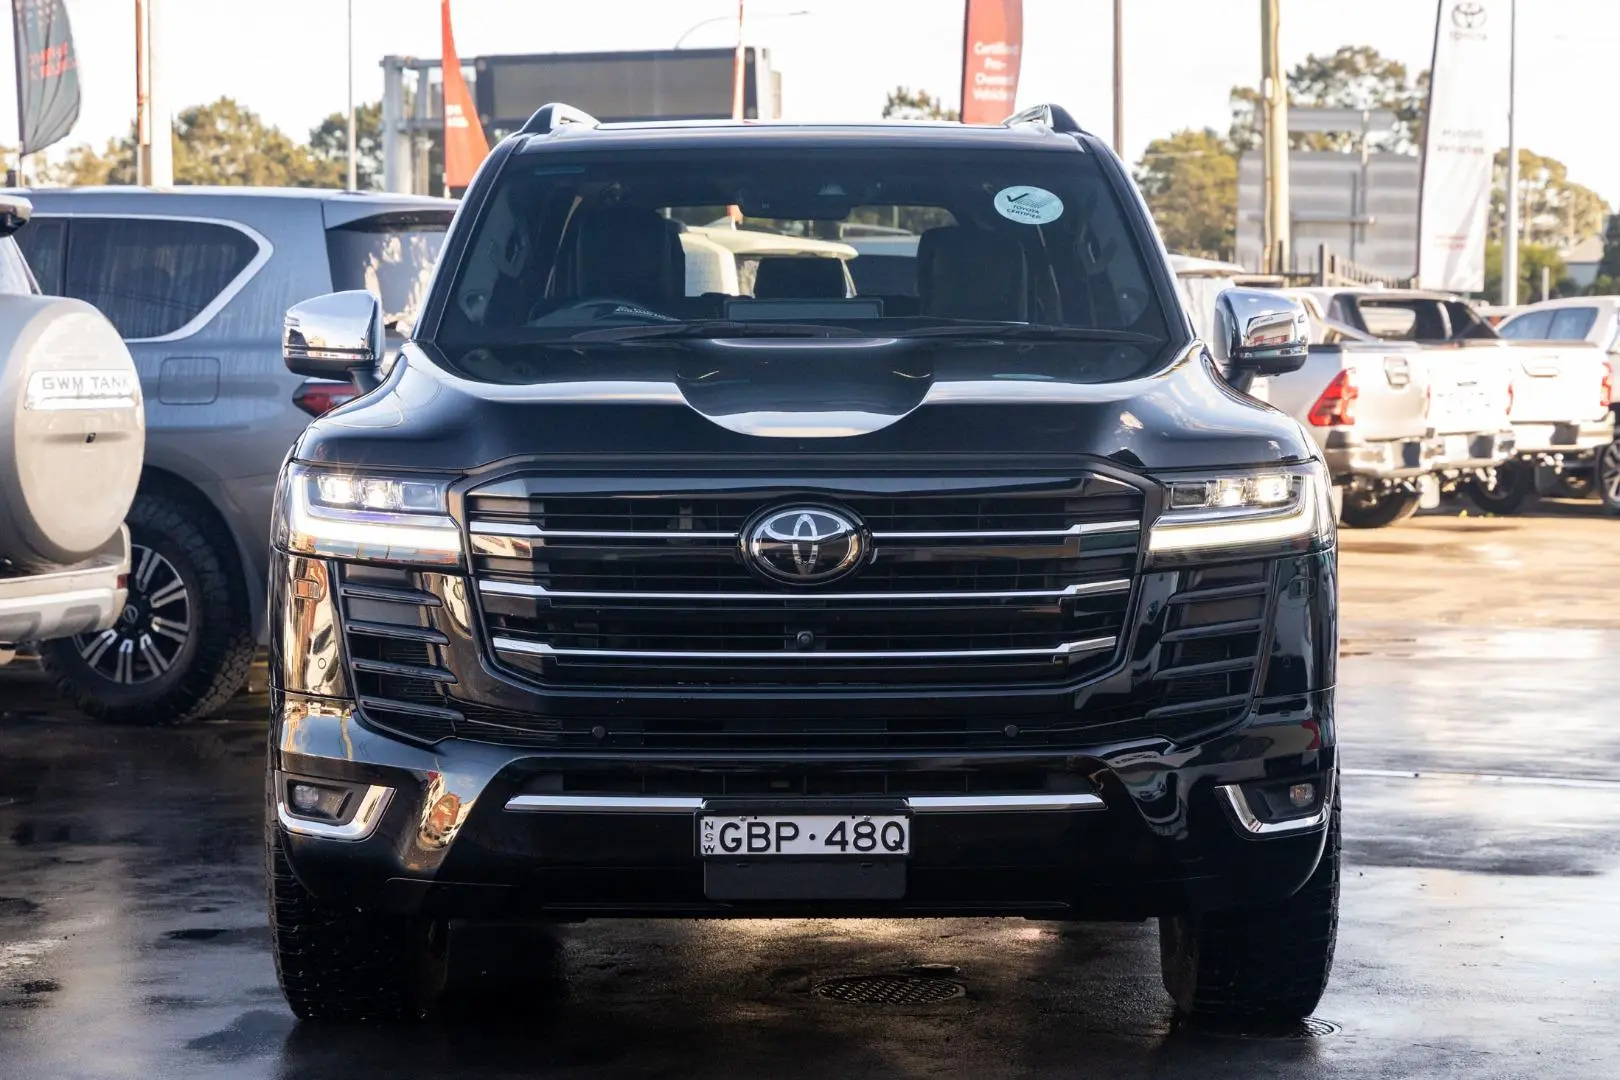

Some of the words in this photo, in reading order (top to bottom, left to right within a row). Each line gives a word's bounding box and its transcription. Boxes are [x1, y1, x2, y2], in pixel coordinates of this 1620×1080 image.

[1013, 205, 1039, 214] TOYOTA
[42, 376, 83, 390] GWM
[90, 376, 129, 389] TANK
